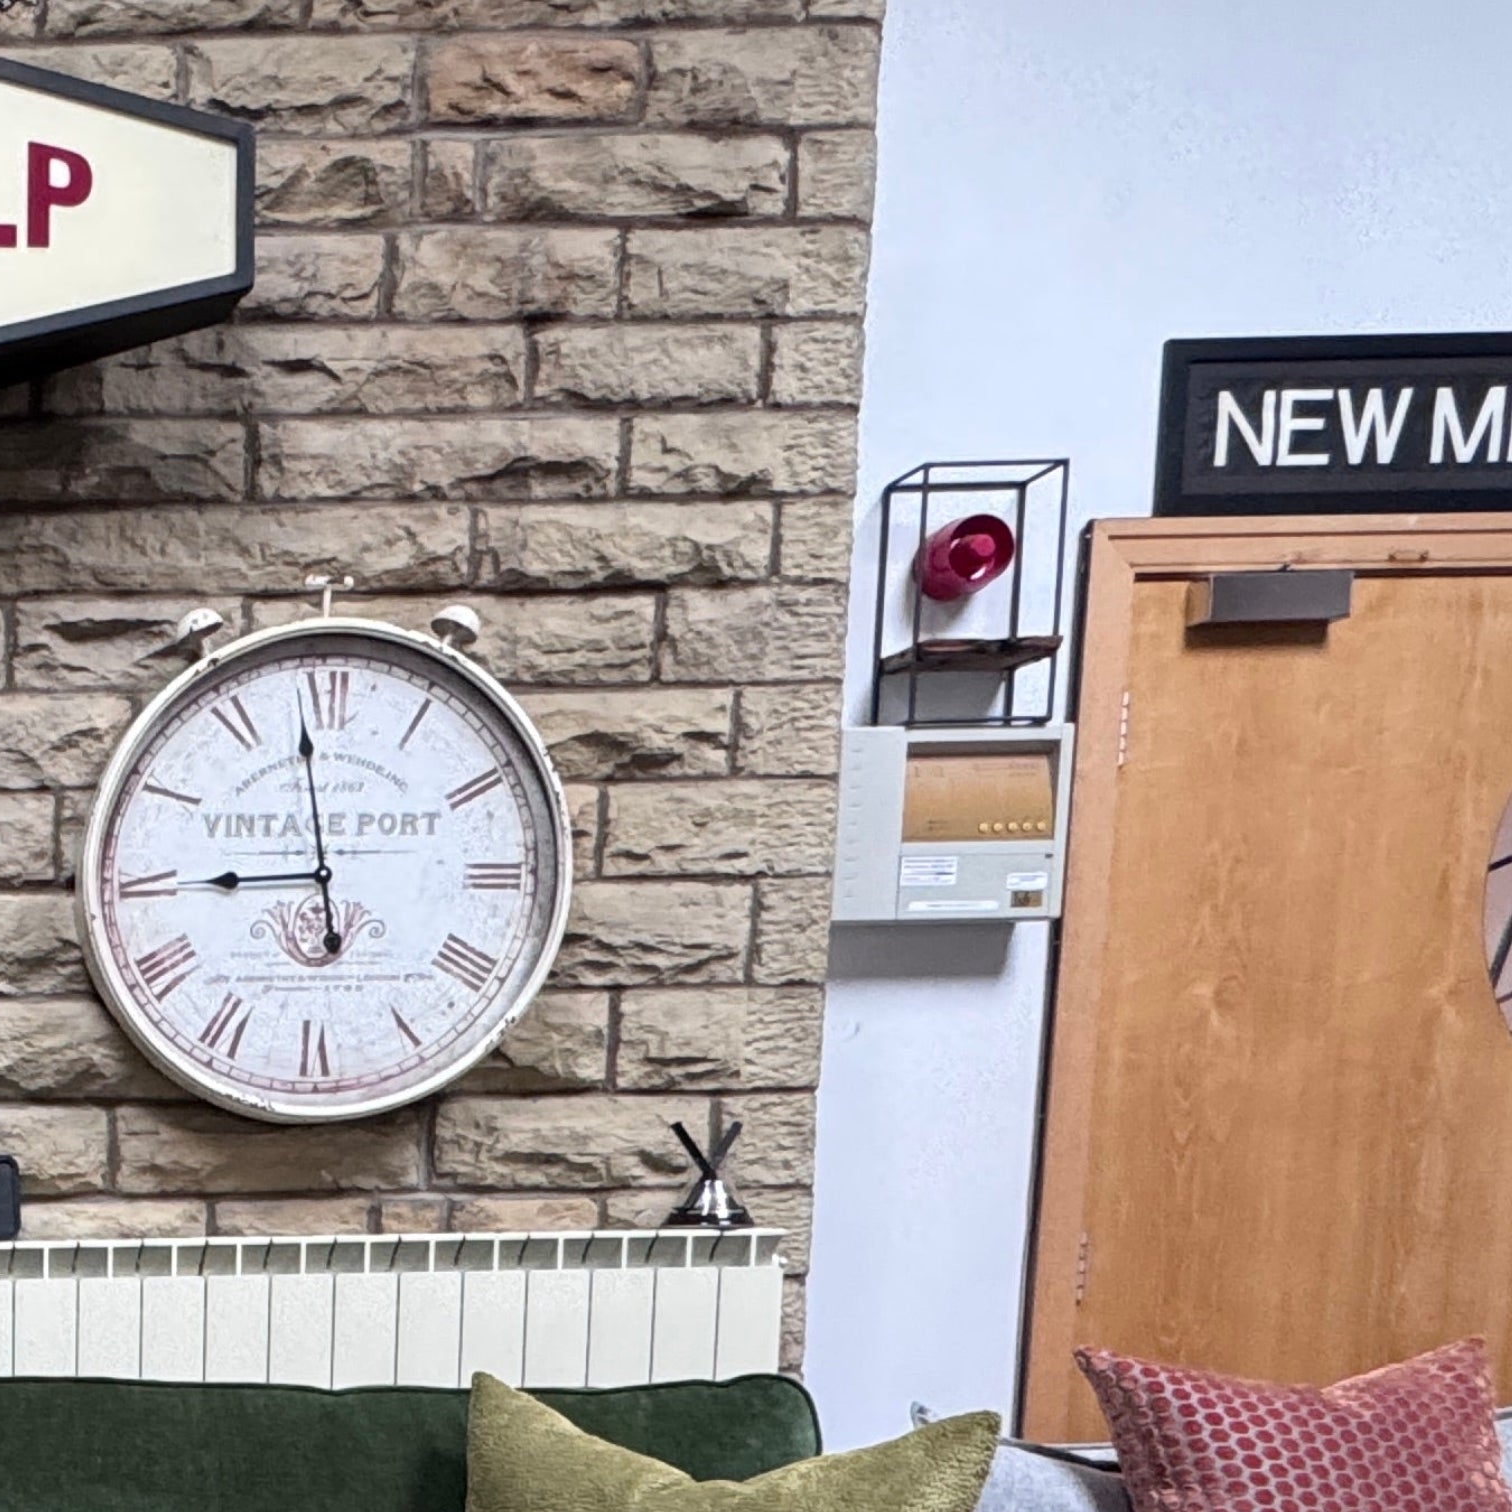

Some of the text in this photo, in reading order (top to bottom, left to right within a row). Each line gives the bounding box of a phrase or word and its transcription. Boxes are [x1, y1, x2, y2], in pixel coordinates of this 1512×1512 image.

[1213, 385, 1512, 467] NEW M
[203, 811, 442, 838] VINTAGE PORT
